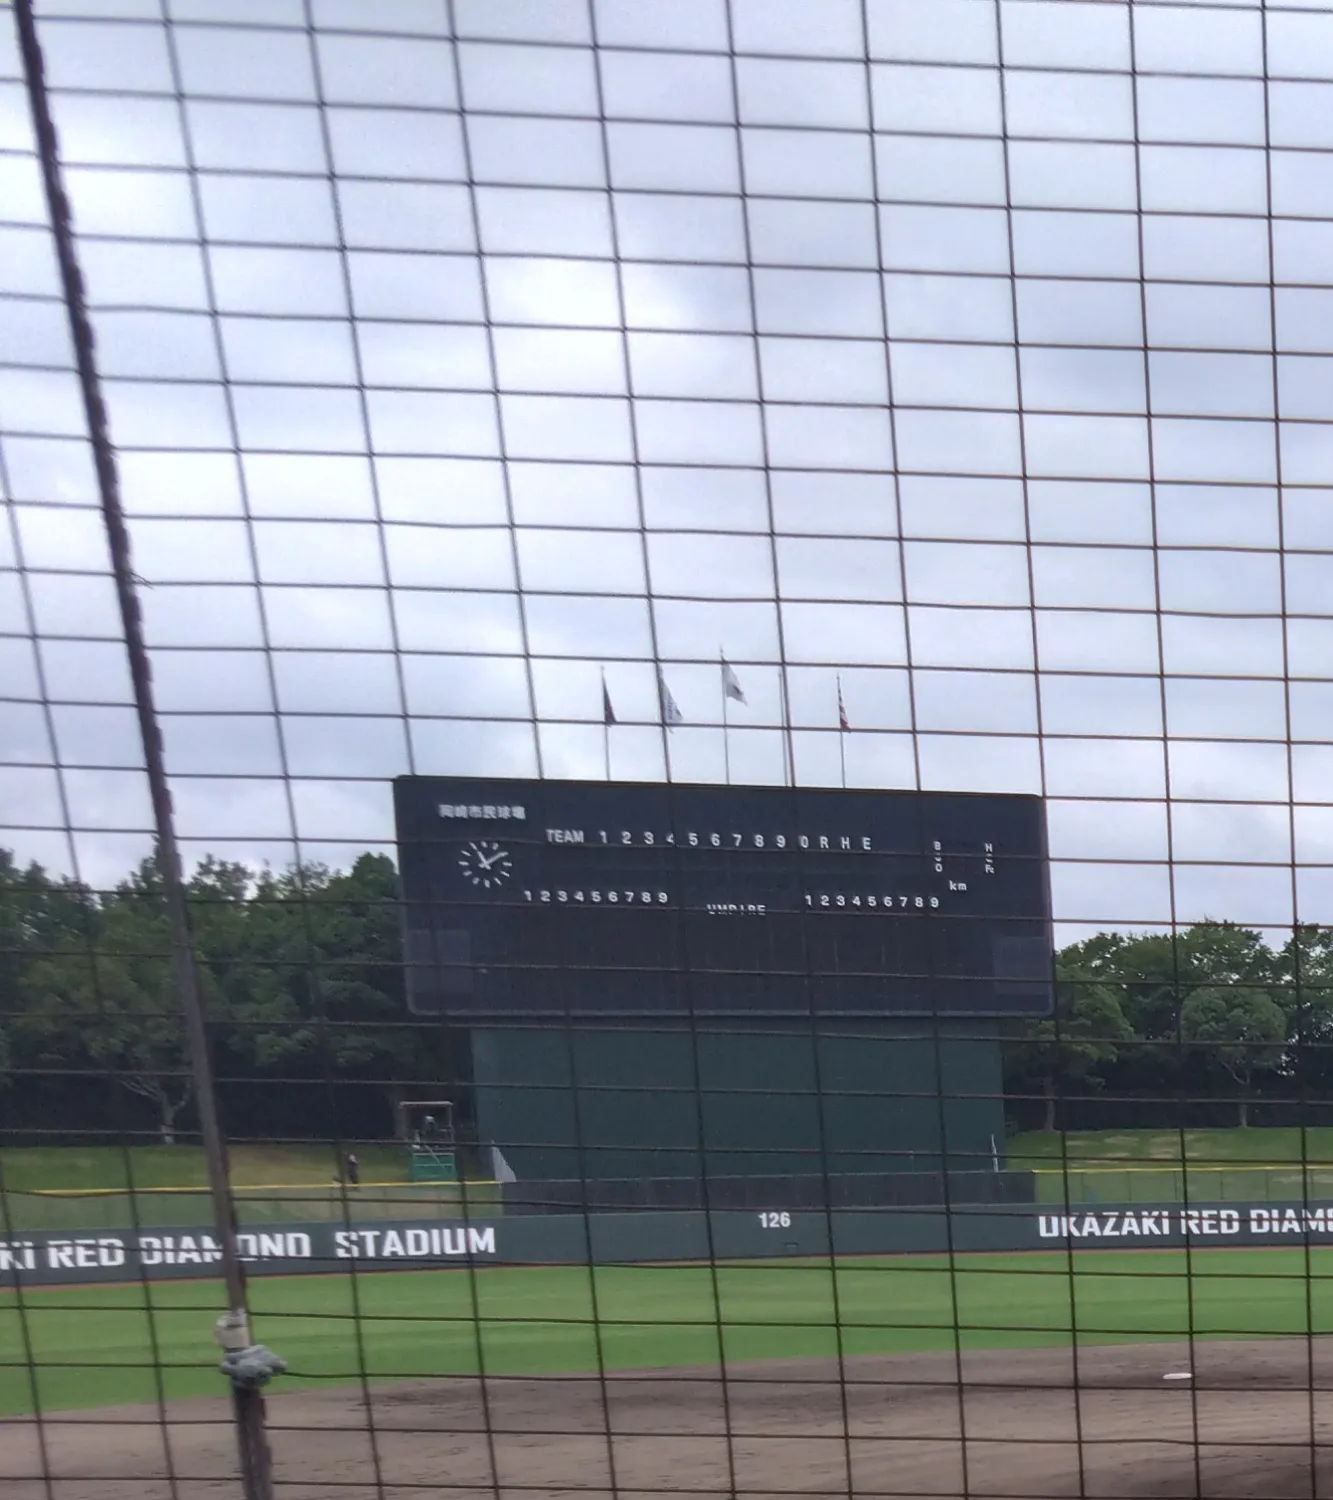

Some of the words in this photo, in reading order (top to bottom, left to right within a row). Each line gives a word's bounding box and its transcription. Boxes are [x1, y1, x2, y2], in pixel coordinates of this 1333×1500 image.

[546, 829, 585, 844] TEAM
[599, 831, 608, 844] 1
[621, 831, 633, 844] 2
[644, 831, 655, 845] 3
[688, 833, 698, 846] 5
[710, 833, 720, 847] 6
[732, 834, 743, 847] 7
[754, 834, 764, 848] 8
[776, 835, 786, 848] 9
[820, 836, 830, 849] R
[841, 837, 851, 849] H
[863, 837, 872, 850] E
[935, 863, 943, 872] O
[949, 880, 967, 891] km
[523, 890, 532, 901] 1
[540, 890, 551, 901] 2
[557, 890, 568, 901] 3
[574, 890, 584, 901] 4
[591, 890, 601, 902] 5
[608, 891, 618, 902] 6
[625, 891, 634, 902] 7
[641, 891, 652, 902] 8
[658, 891, 668, 903] 9
[804, 895, 812, 906] 1
[820, 895, 830, 906] 2
[836, 895, 845, 906] 3
[852, 895, 861, 906] 4
[868, 896, 877, 907] 5
[883, 896, 893, 907] 6
[900, 896, 908, 907] 7
[915, 896, 924, 907] 8
[930, 897, 939, 908] 9
[757, 1212, 791, 1228] 126
[1038, 1210, 1170, 1237] OKAZAKI
[1180, 1209, 1240, 1235] RED
[46, 1238, 125, 1268] RED
[334, 1227, 496, 1258] STADIUM
